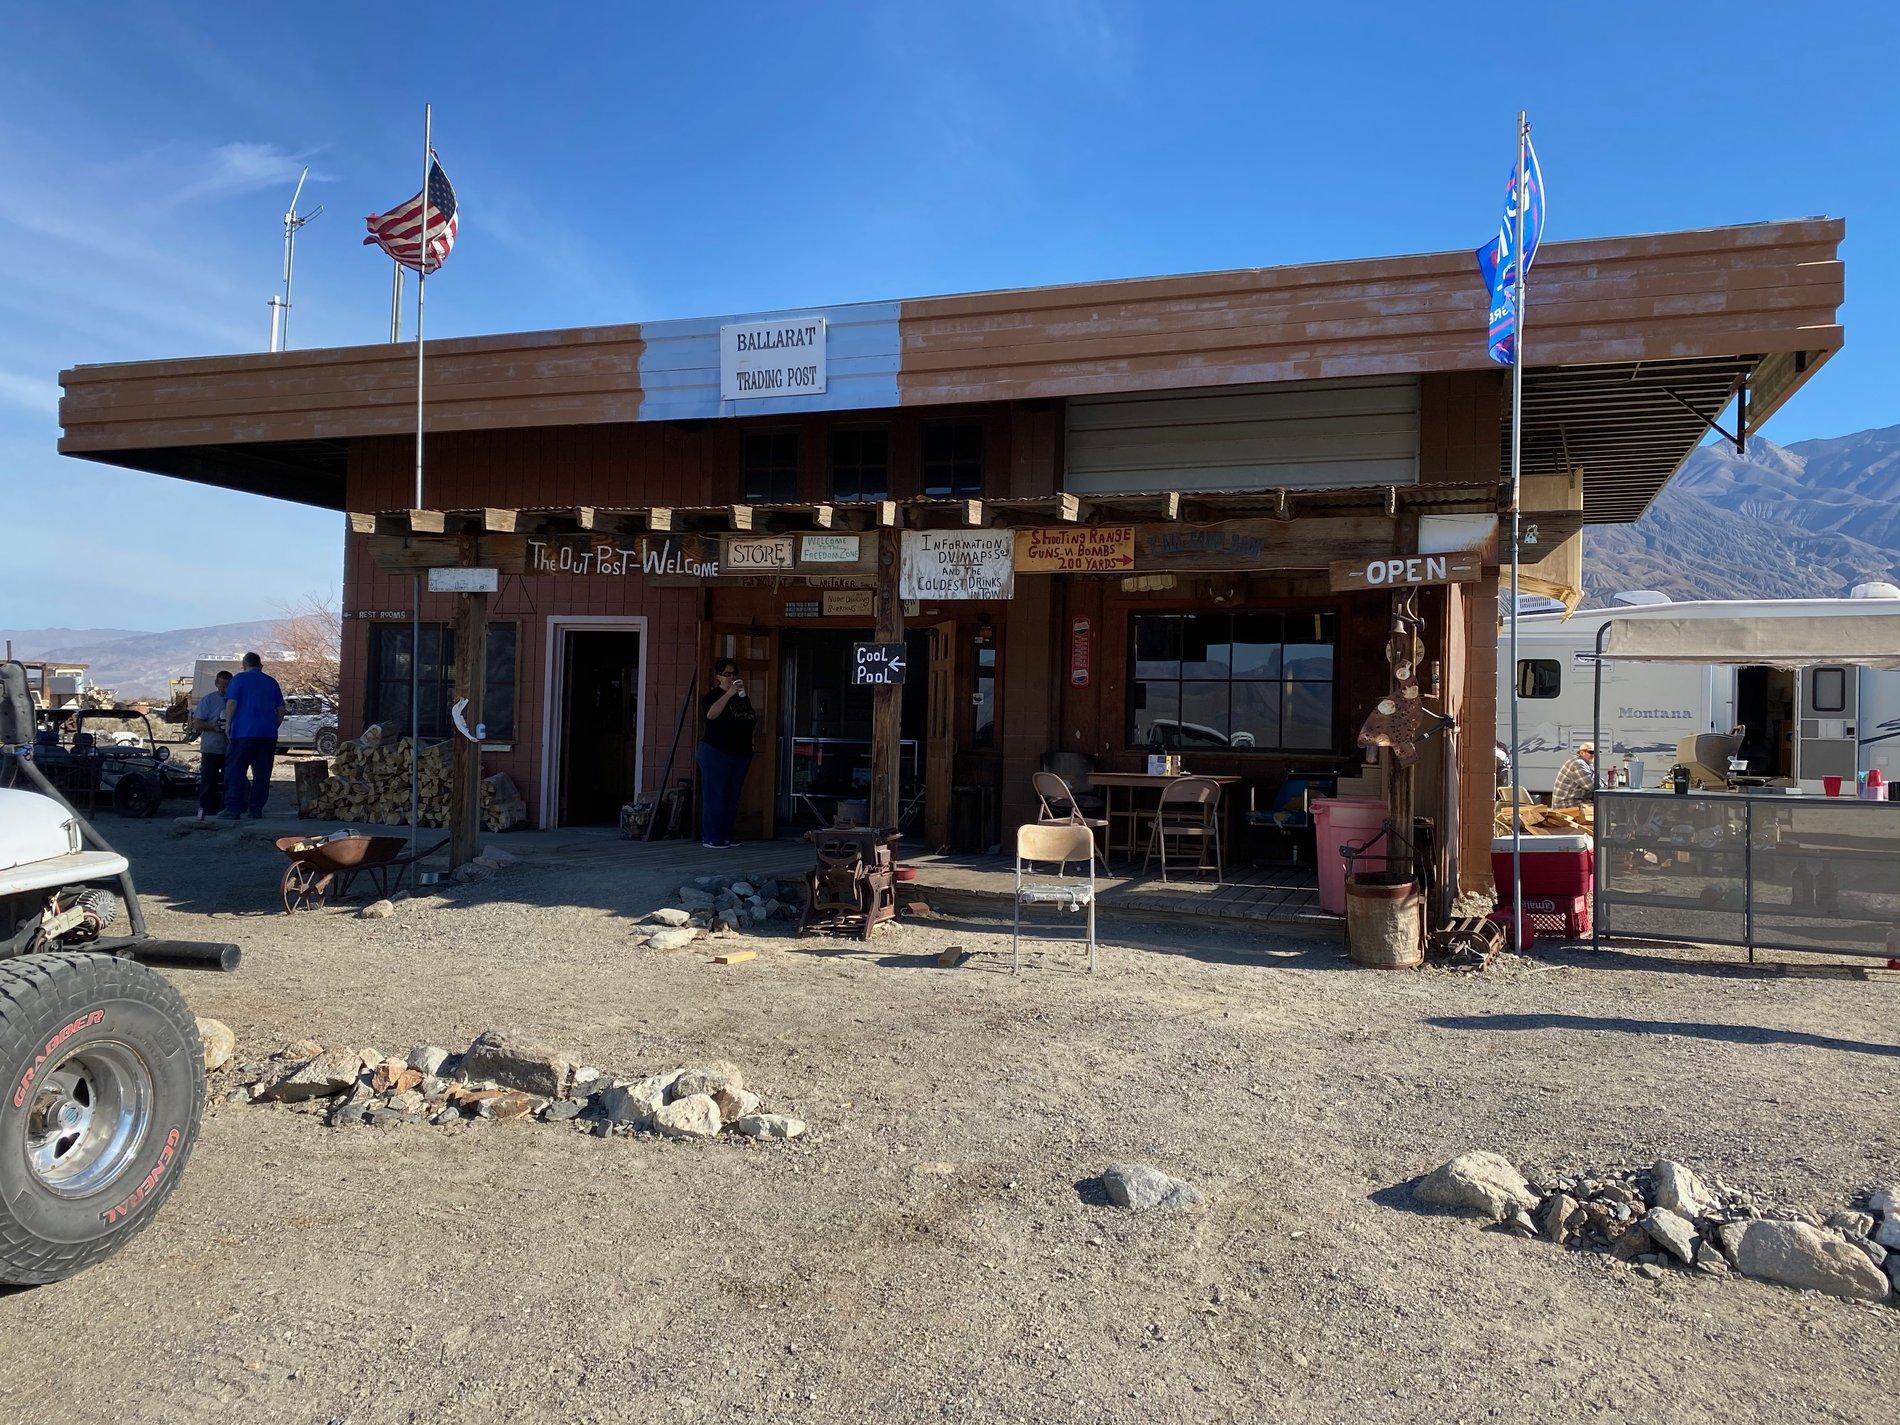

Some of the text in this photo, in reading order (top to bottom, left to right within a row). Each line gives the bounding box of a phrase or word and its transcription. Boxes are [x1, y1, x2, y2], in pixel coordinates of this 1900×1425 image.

[736, 327, 816, 352] BALLARAT
[736, 366, 817, 391] TRADING POST
[733, 543, 785, 565] STORE
[804, 547, 860, 560] FREEDOM ZONE
[941, 567, 961, 576] AND
[1058, 557, 1117, 570] 200 YARDS
[917, 576, 1002, 592] CoLDEST DRiNKS
[358, 610, 406, 619] REST ROOMS
[857, 647, 889, 664] CooL
[857, 665, 892, 684] PooL
[1617, 706, 1694, 719] Montana
[14, 1008, 105, 1107] GRABBER
[101, 1128, 180, 1225] GENERAL
